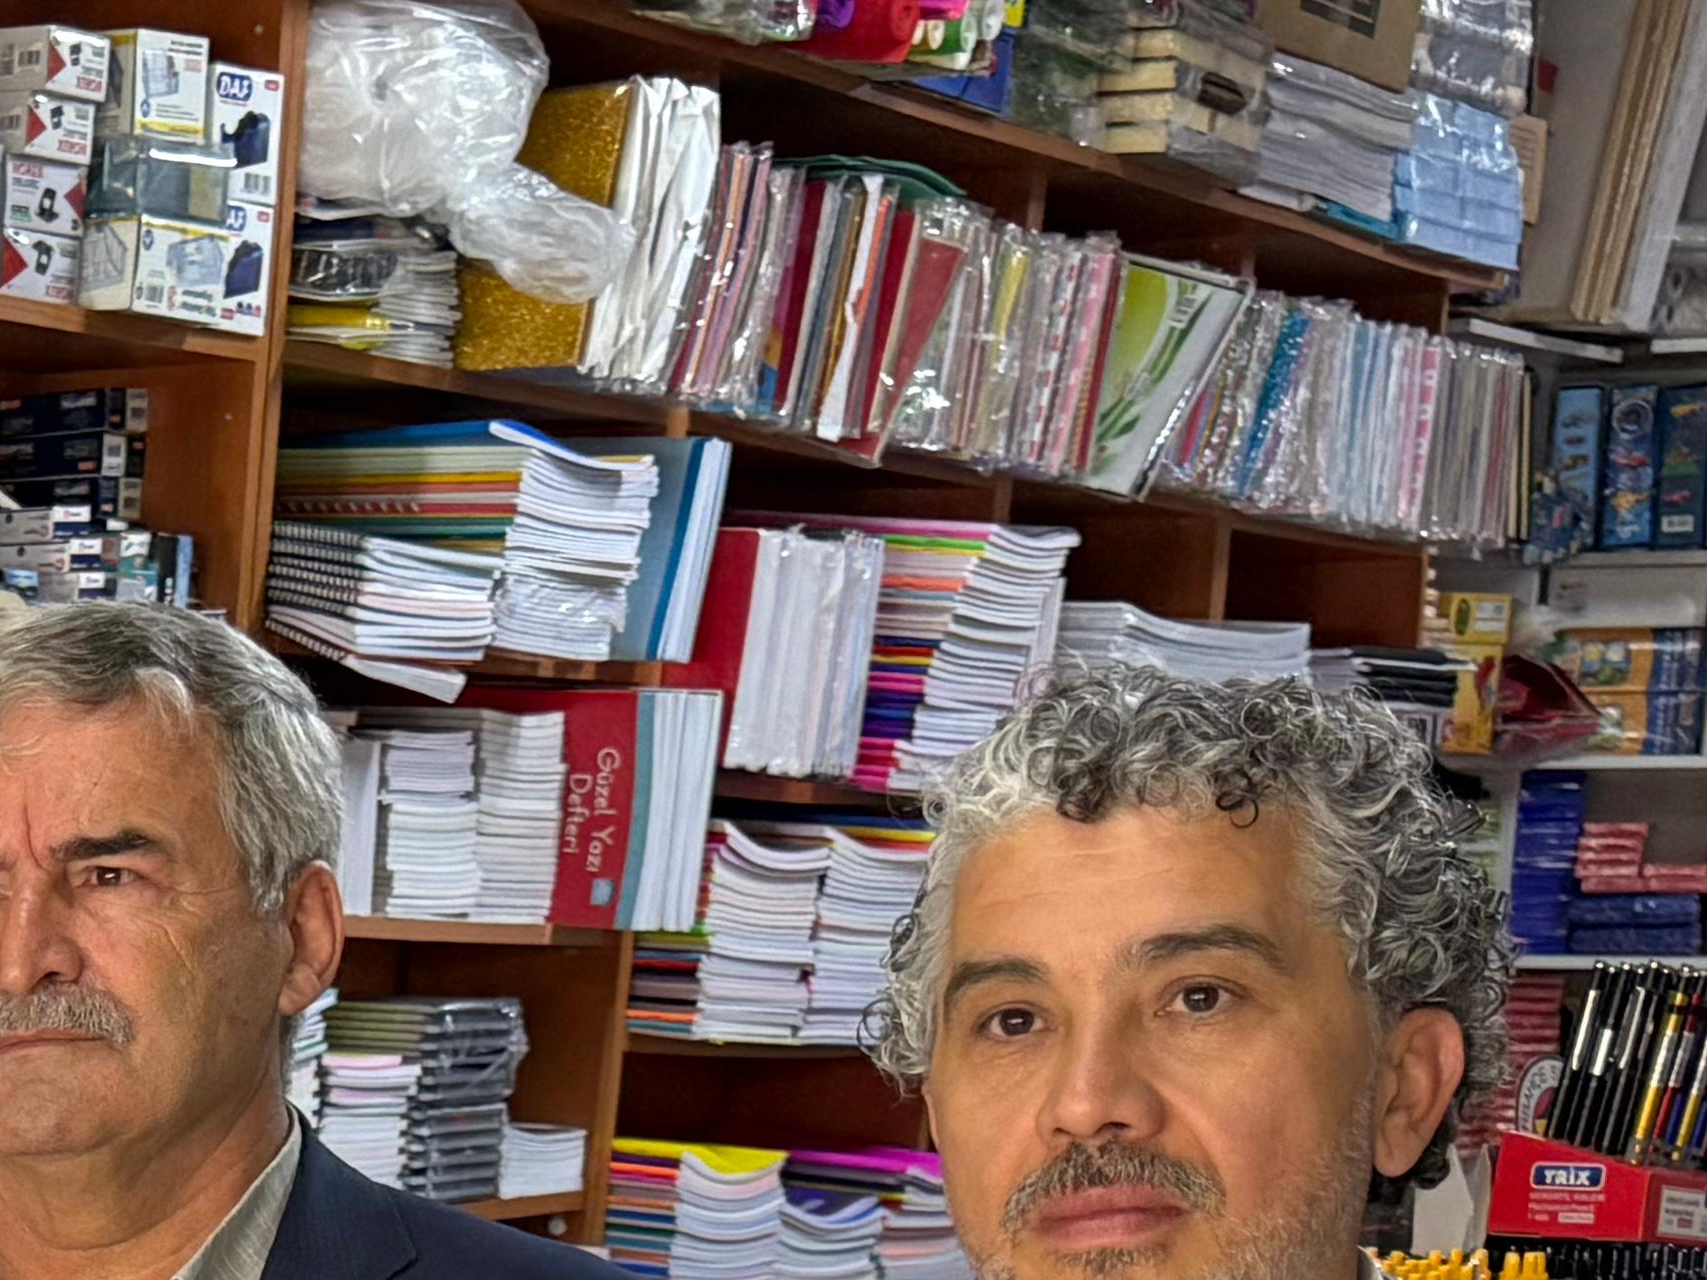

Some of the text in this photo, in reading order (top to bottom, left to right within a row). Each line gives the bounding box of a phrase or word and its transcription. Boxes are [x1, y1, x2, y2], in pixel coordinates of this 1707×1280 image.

[562, 773, 594, 854] Defteri
[586, 746, 621, 873] Güzel Yazı
